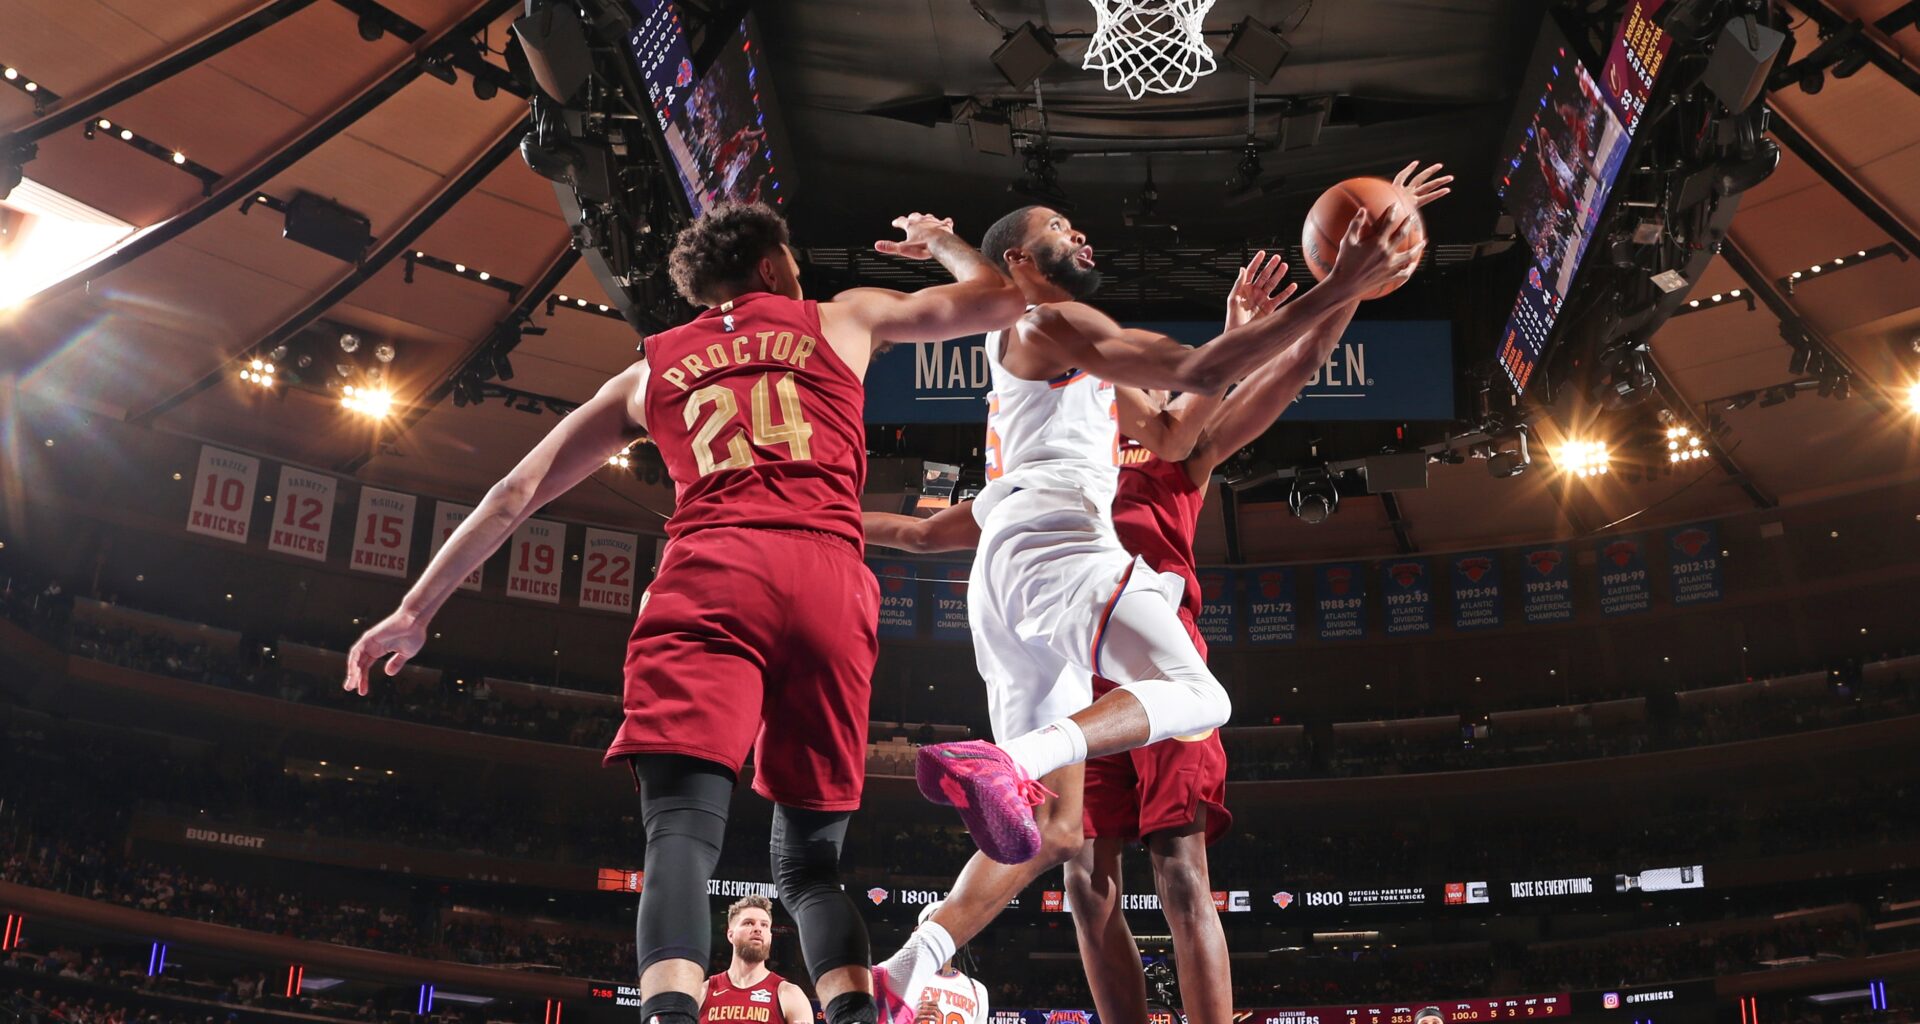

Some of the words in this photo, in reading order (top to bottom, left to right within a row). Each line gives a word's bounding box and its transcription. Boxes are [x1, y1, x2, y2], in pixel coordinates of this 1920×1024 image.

[1625, 1, 1642, 41] MOBLEY
[1631, 17, 1646, 49] TYSON
[1648, 50, 1663, 77] WADE
[664, 85, 676, 106] 44
[1620, 89, 1633, 111] 33
[662, 331, 817, 391] PROCTOR
[682, 371, 813, 478] 24
[202, 473, 245, 512] 10
[283, 494, 323, 532] 12
[191, 510, 246, 537] KNICKS
[364, 513, 404, 549] 15
[273, 530, 325, 554] KNICKS
[354, 549, 406, 571] KNICKS
[518, 542, 555, 575] 19
[586, 552, 631, 587] 22
[1673, 559, 1716, 575] 2012-13
[1603, 570, 1645, 585] 1998-99
[1679, 573, 1712, 584] ATLANTIC
[510, 577, 558, 597] KNICKS
[1456, 587, 1498, 599] 1993-94
[1526, 580, 1568, 592] 1993-94
[1608, 584, 1641, 595] EASTERN
[1680, 583, 1712, 593] DIVISION
[583, 588, 630, 607] KNICKS
[1387, 593, 1429, 605] 1992-93
[1531, 594, 1564, 603] EASTERN
[1601, 592, 1649, 605] CONFERENCE
[1675, 590, 1719, 603] CHAMPIONS
[1252, 603, 1292, 614] 1971-72
[1320, 599, 1361, 610] 1988-89
[1391, 607, 1424, 615] ATLANTIC
[1460, 600, 1493, 609] ATLANTIC
[1524, 601, 1571, 612] CONFERENCE
[1604, 602, 1647, 614] CHAMPIONS
[1256, 616, 1288, 624] EASTERN
[1324, 612, 1357, 620] ATLANTIC
[1393, 615, 1423, 623] DIVISION
[1462, 609, 1492, 618] DIVISION
[1528, 611, 1569, 621] CHAMPIONS
[1249, 624, 1295, 633] CONFERENCE
[1326, 621, 1356, 629] DIVISION
[1388, 623, 1429, 632] CHAMPIONS
[1457, 617, 1498, 627] CHAMPIONS
[1252, 633, 1293, 641] CHAMPIONS
[1321, 628, 1362, 637] CHAMPIONS
[186, 828, 219, 842] BUD
[220, 832, 265, 849] LIGHT
[722, 880, 730, 896] IS
[1510, 881, 1534, 898] TASTE
[1535, 880, 1544, 897] IS
[1544, 877, 1593, 896] EVERYTHING
[901, 890, 938, 905] 1800
[1130, 894, 1138, 910] IS
[1306, 891, 1343, 906] 1800
[592, 989, 613, 998] 7:55
[1626, 990, 1674, 1004] @NYKNICKS
[616, 997, 641, 1007] MAGI
[921, 987, 942, 1001] EW
[942, 990, 976, 1017] YORK
[708, 1005, 769, 1023] CLEVELAND
[1372, 1016, 1378, 1024] 5
[1391, 1015, 1412, 1023] 35.3
[1452, 1012, 1478, 1020] 100.0
[1490, 1010, 1497, 1018] 5
[1509, 1009, 1516, 1017] 3
[1527, 1007, 1534, 1015] 9
[1546, 1006, 1553, 1014] 9
